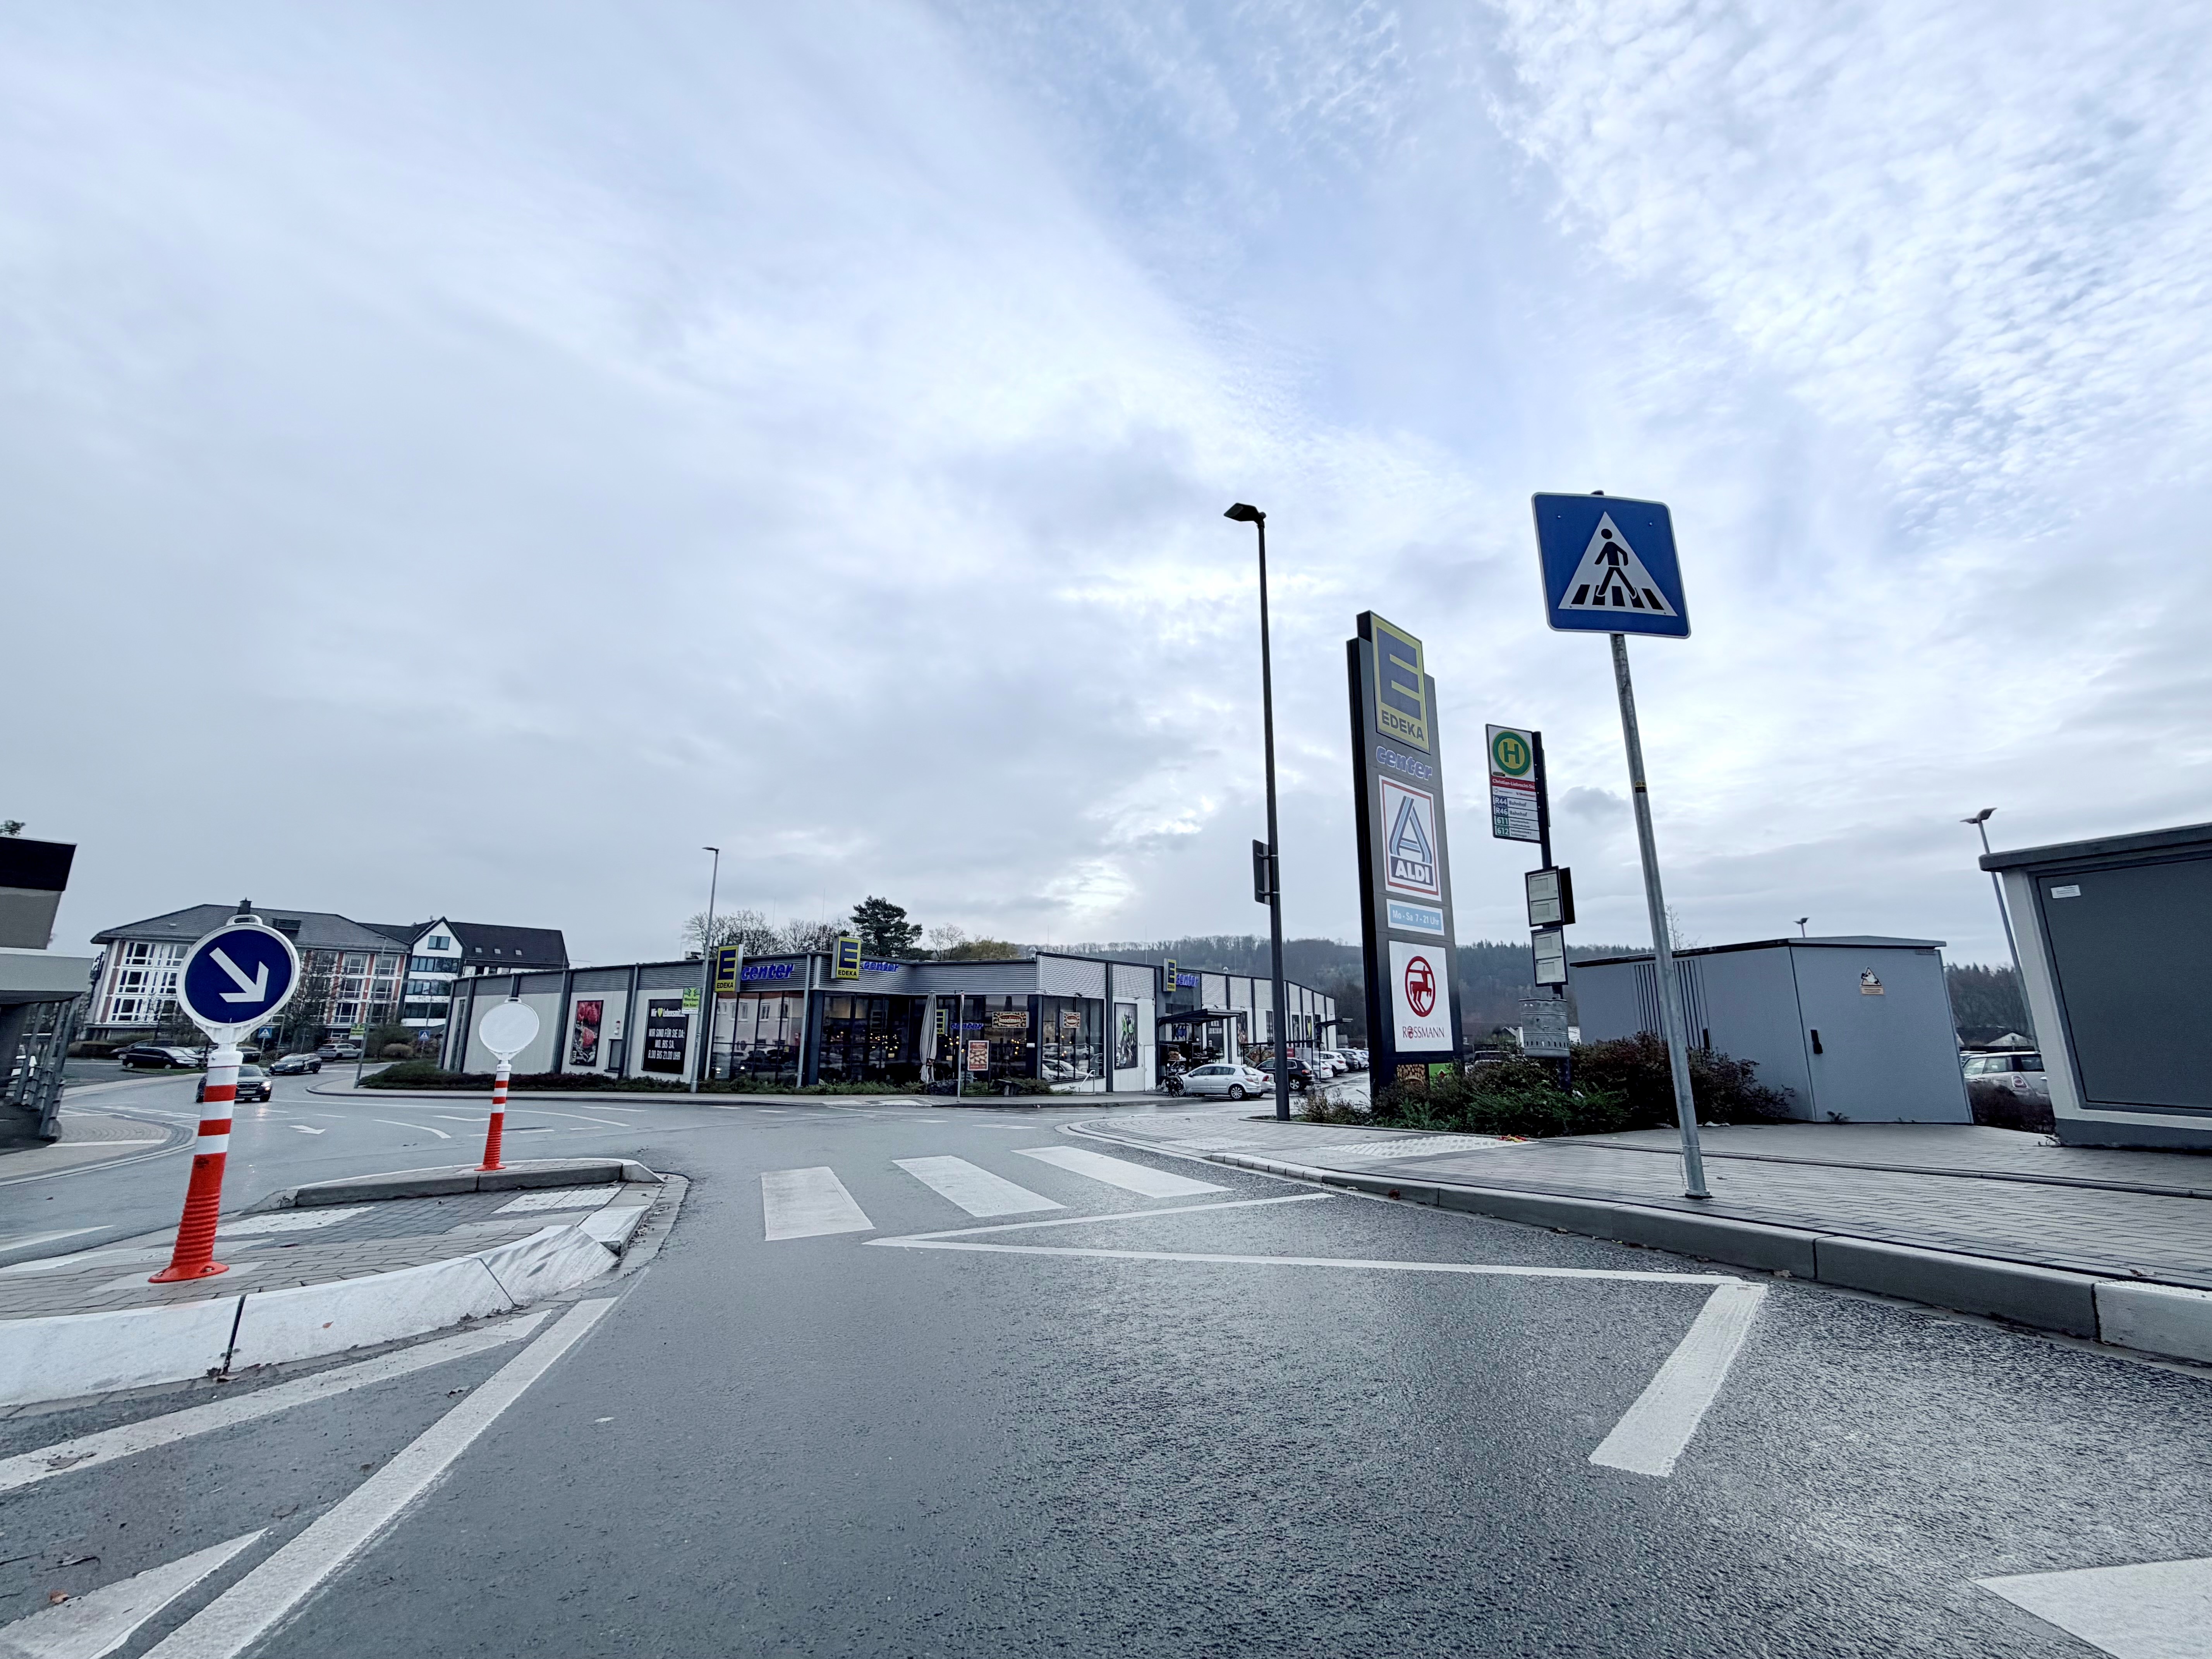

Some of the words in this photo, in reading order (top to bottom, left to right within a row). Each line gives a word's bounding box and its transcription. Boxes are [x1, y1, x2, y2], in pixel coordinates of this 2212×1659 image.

[1381, 710, 1424, 741] EDEKA
[1503, 742, 1520, 764] H
[1376, 746, 1432, 781] center
[1495, 797, 1507, 805] R44
[1496, 807, 1508, 815] R46
[1497, 817, 1508, 825] 611
[1395, 860, 1431, 883] ALDI
[1393, 910, 1401, 919] Mo
[1406, 912, 1413, 921] Sa
[1423, 915, 1429, 924] 21
[1430, 916, 1439, 925] Uhr
[741, 963, 795, 981] center
[863, 961, 899, 972] center
[656, 1029, 664, 1037] SIND
[1402, 1025, 1445, 1039] ROSSMANN
[673, 1051, 681, 1060] UHR
